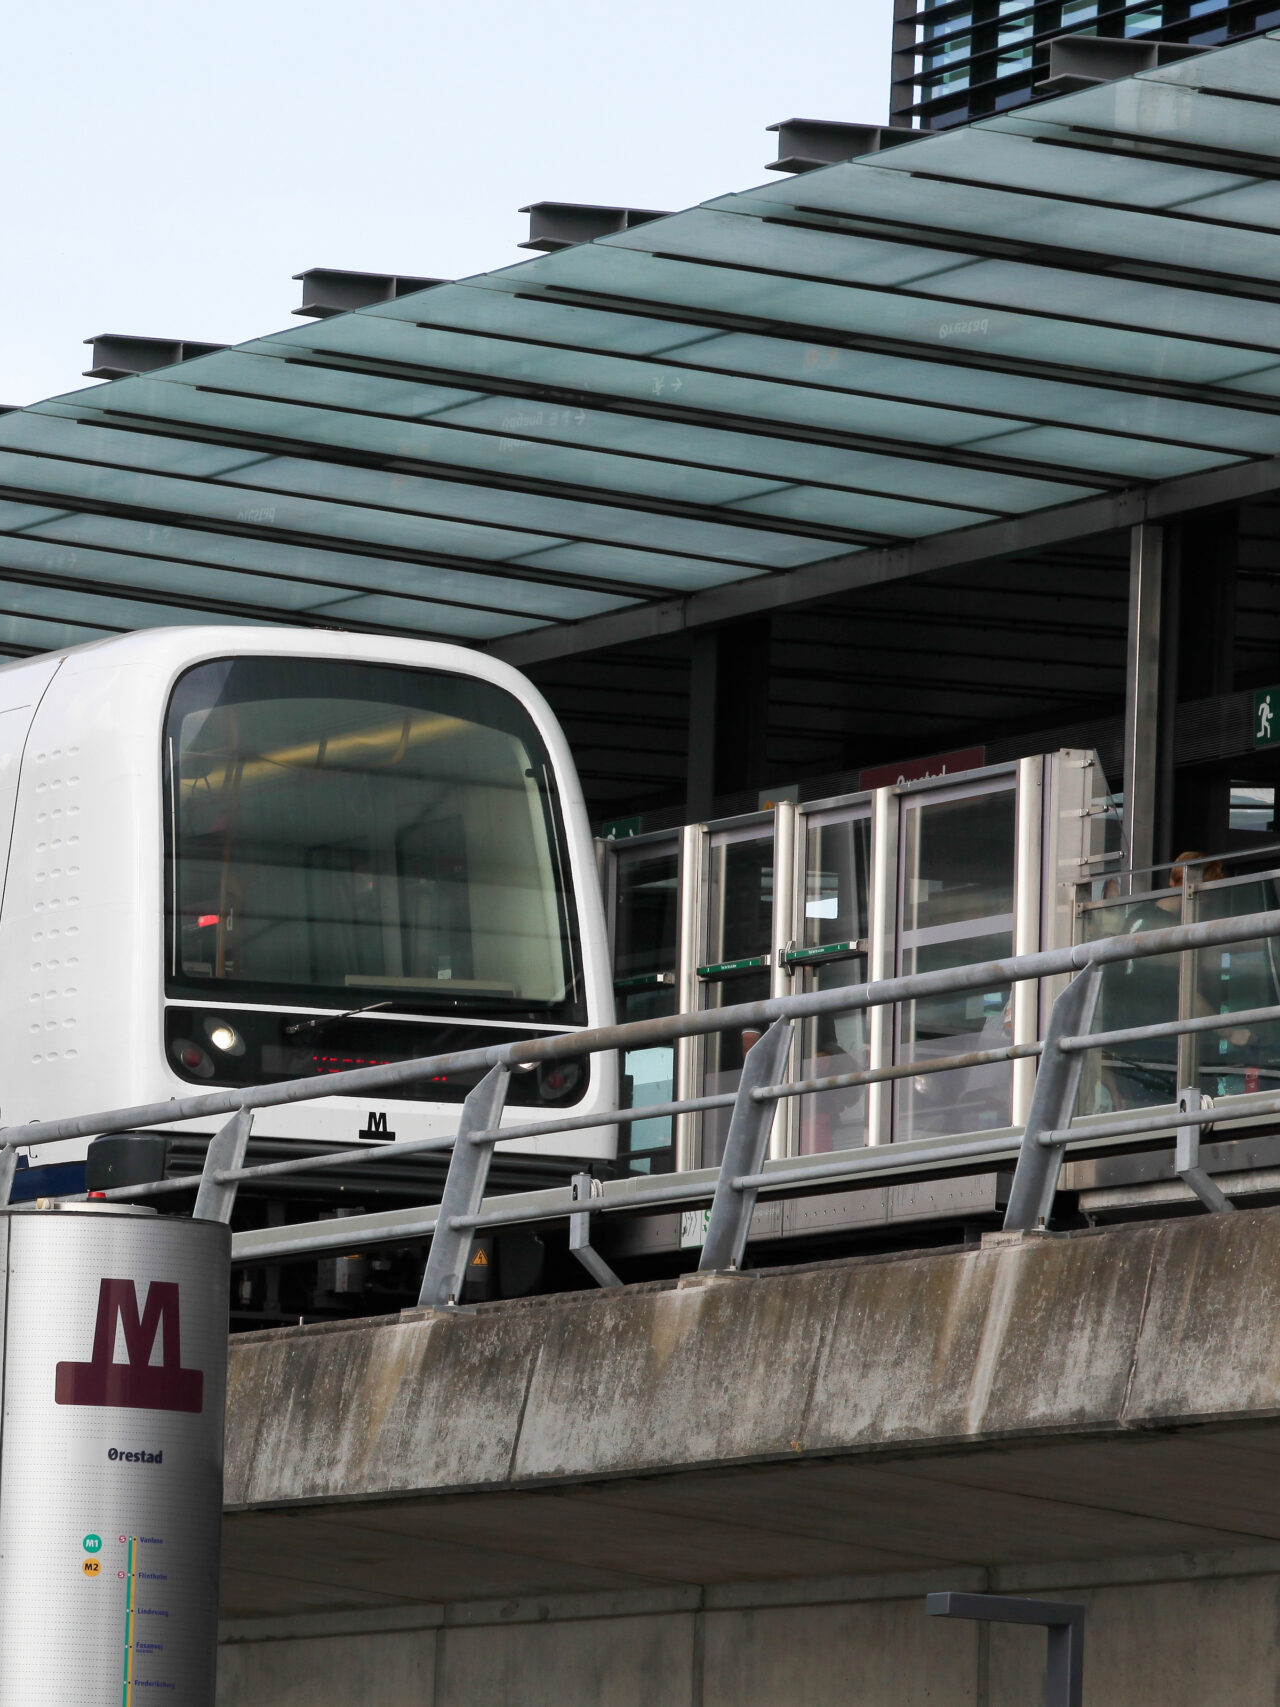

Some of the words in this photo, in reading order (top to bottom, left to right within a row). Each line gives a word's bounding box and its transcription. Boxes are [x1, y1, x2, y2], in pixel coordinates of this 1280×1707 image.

[107, 1447, 163, 1465] Ørestad
[85, 1539, 99, 1548] M1
[84, 1563, 99, 1571] M2
